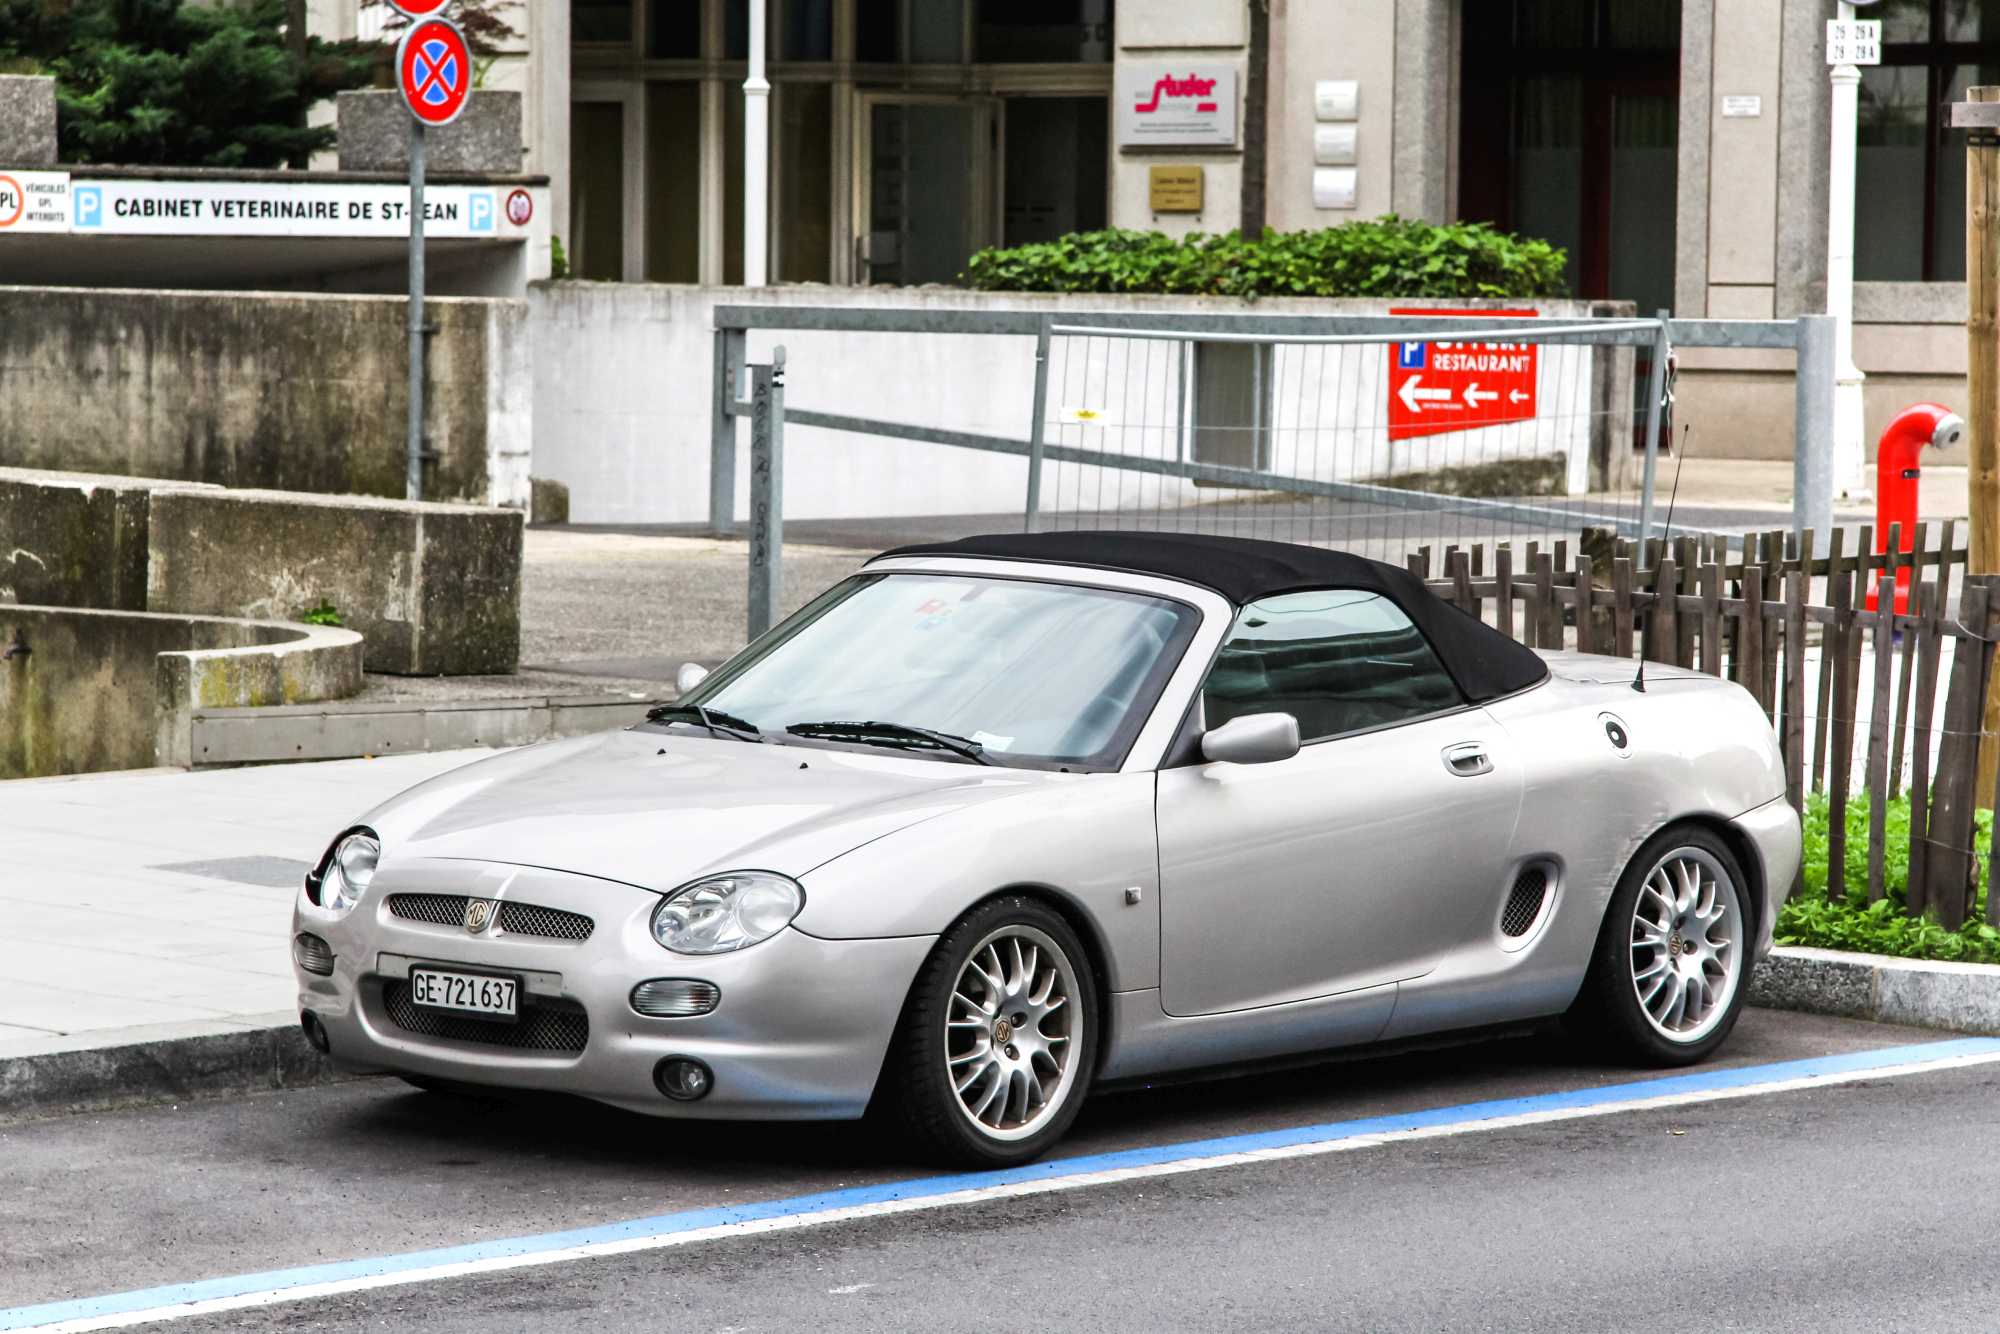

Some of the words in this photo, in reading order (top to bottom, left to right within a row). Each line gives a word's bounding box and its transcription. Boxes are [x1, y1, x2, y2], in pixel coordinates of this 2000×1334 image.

[114, 198, 203, 217] CABINET
[211, 199, 339, 219] VETERINAIRE
[348, 202, 373, 220] DE
[382, 202, 457, 220] ST-EAN
[1433, 354, 1531, 373] RESTAURANT
